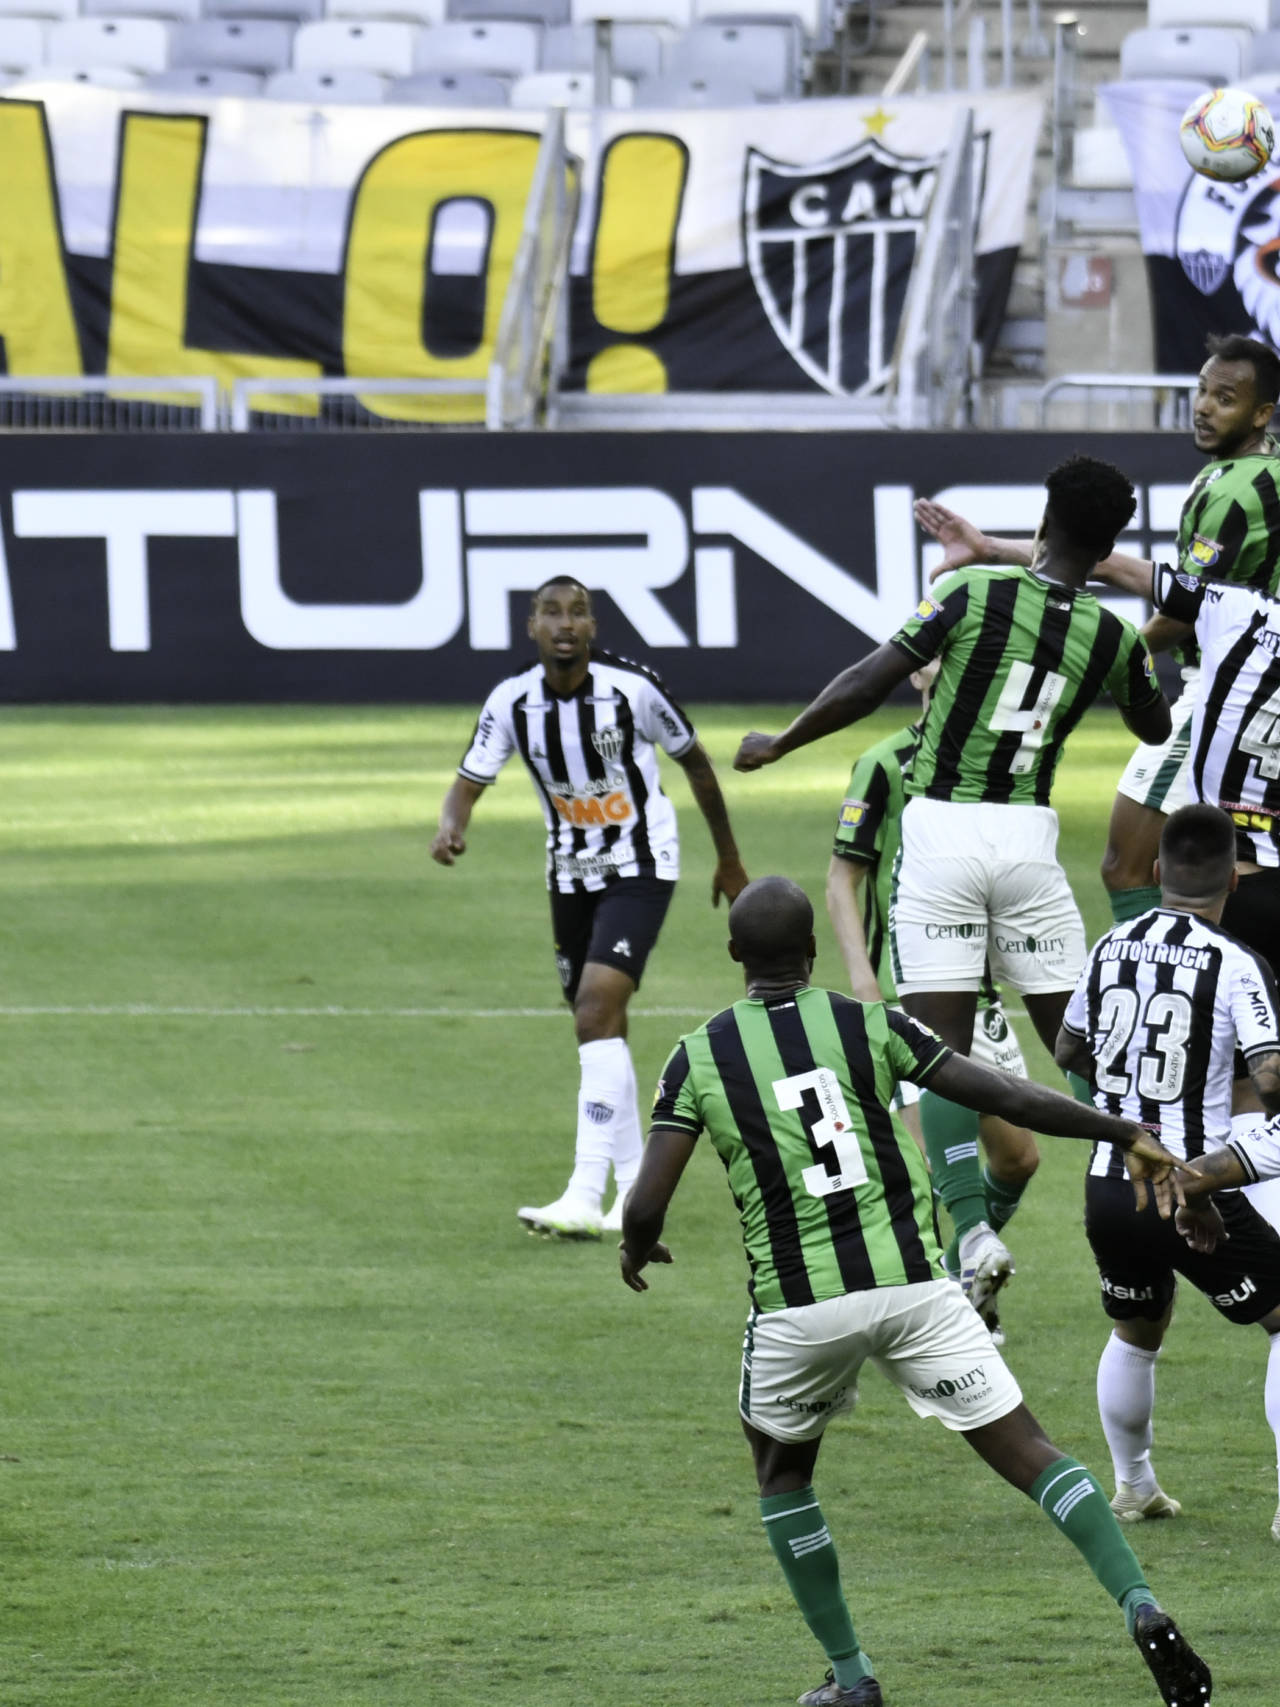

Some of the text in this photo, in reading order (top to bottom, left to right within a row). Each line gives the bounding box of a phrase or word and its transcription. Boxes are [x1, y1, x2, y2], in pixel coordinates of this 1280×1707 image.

[988, 659, 1069, 775] 4
[1098, 939, 1213, 971] AUTO TRUCK
[1246, 989, 1271, 1031] MRV
[1095, 987, 1192, 1102] 23
[771, 1066, 870, 1198] 3
